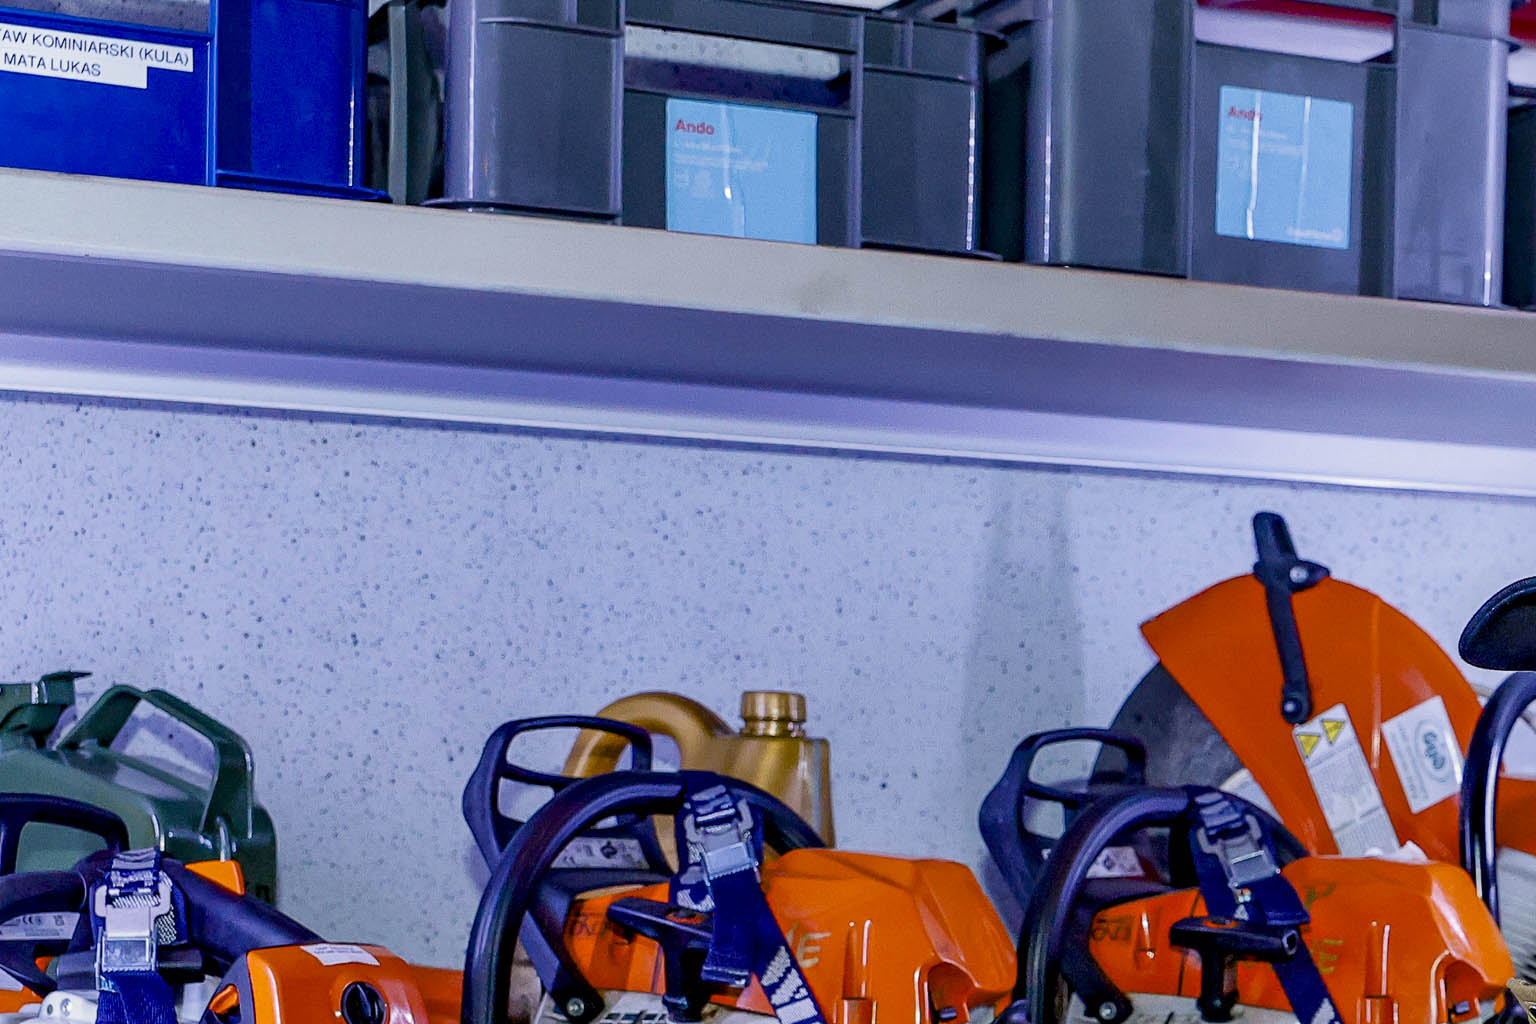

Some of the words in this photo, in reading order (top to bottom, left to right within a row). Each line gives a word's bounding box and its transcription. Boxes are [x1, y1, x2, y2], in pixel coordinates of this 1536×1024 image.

[0, 28, 27, 44] AW
[32, 33, 134, 58] KOMINIARSKI
[138, 47, 189, 66] (KULA)
[4, 52, 46, 69] MATA
[50, 58, 101, 77] LUKAS
